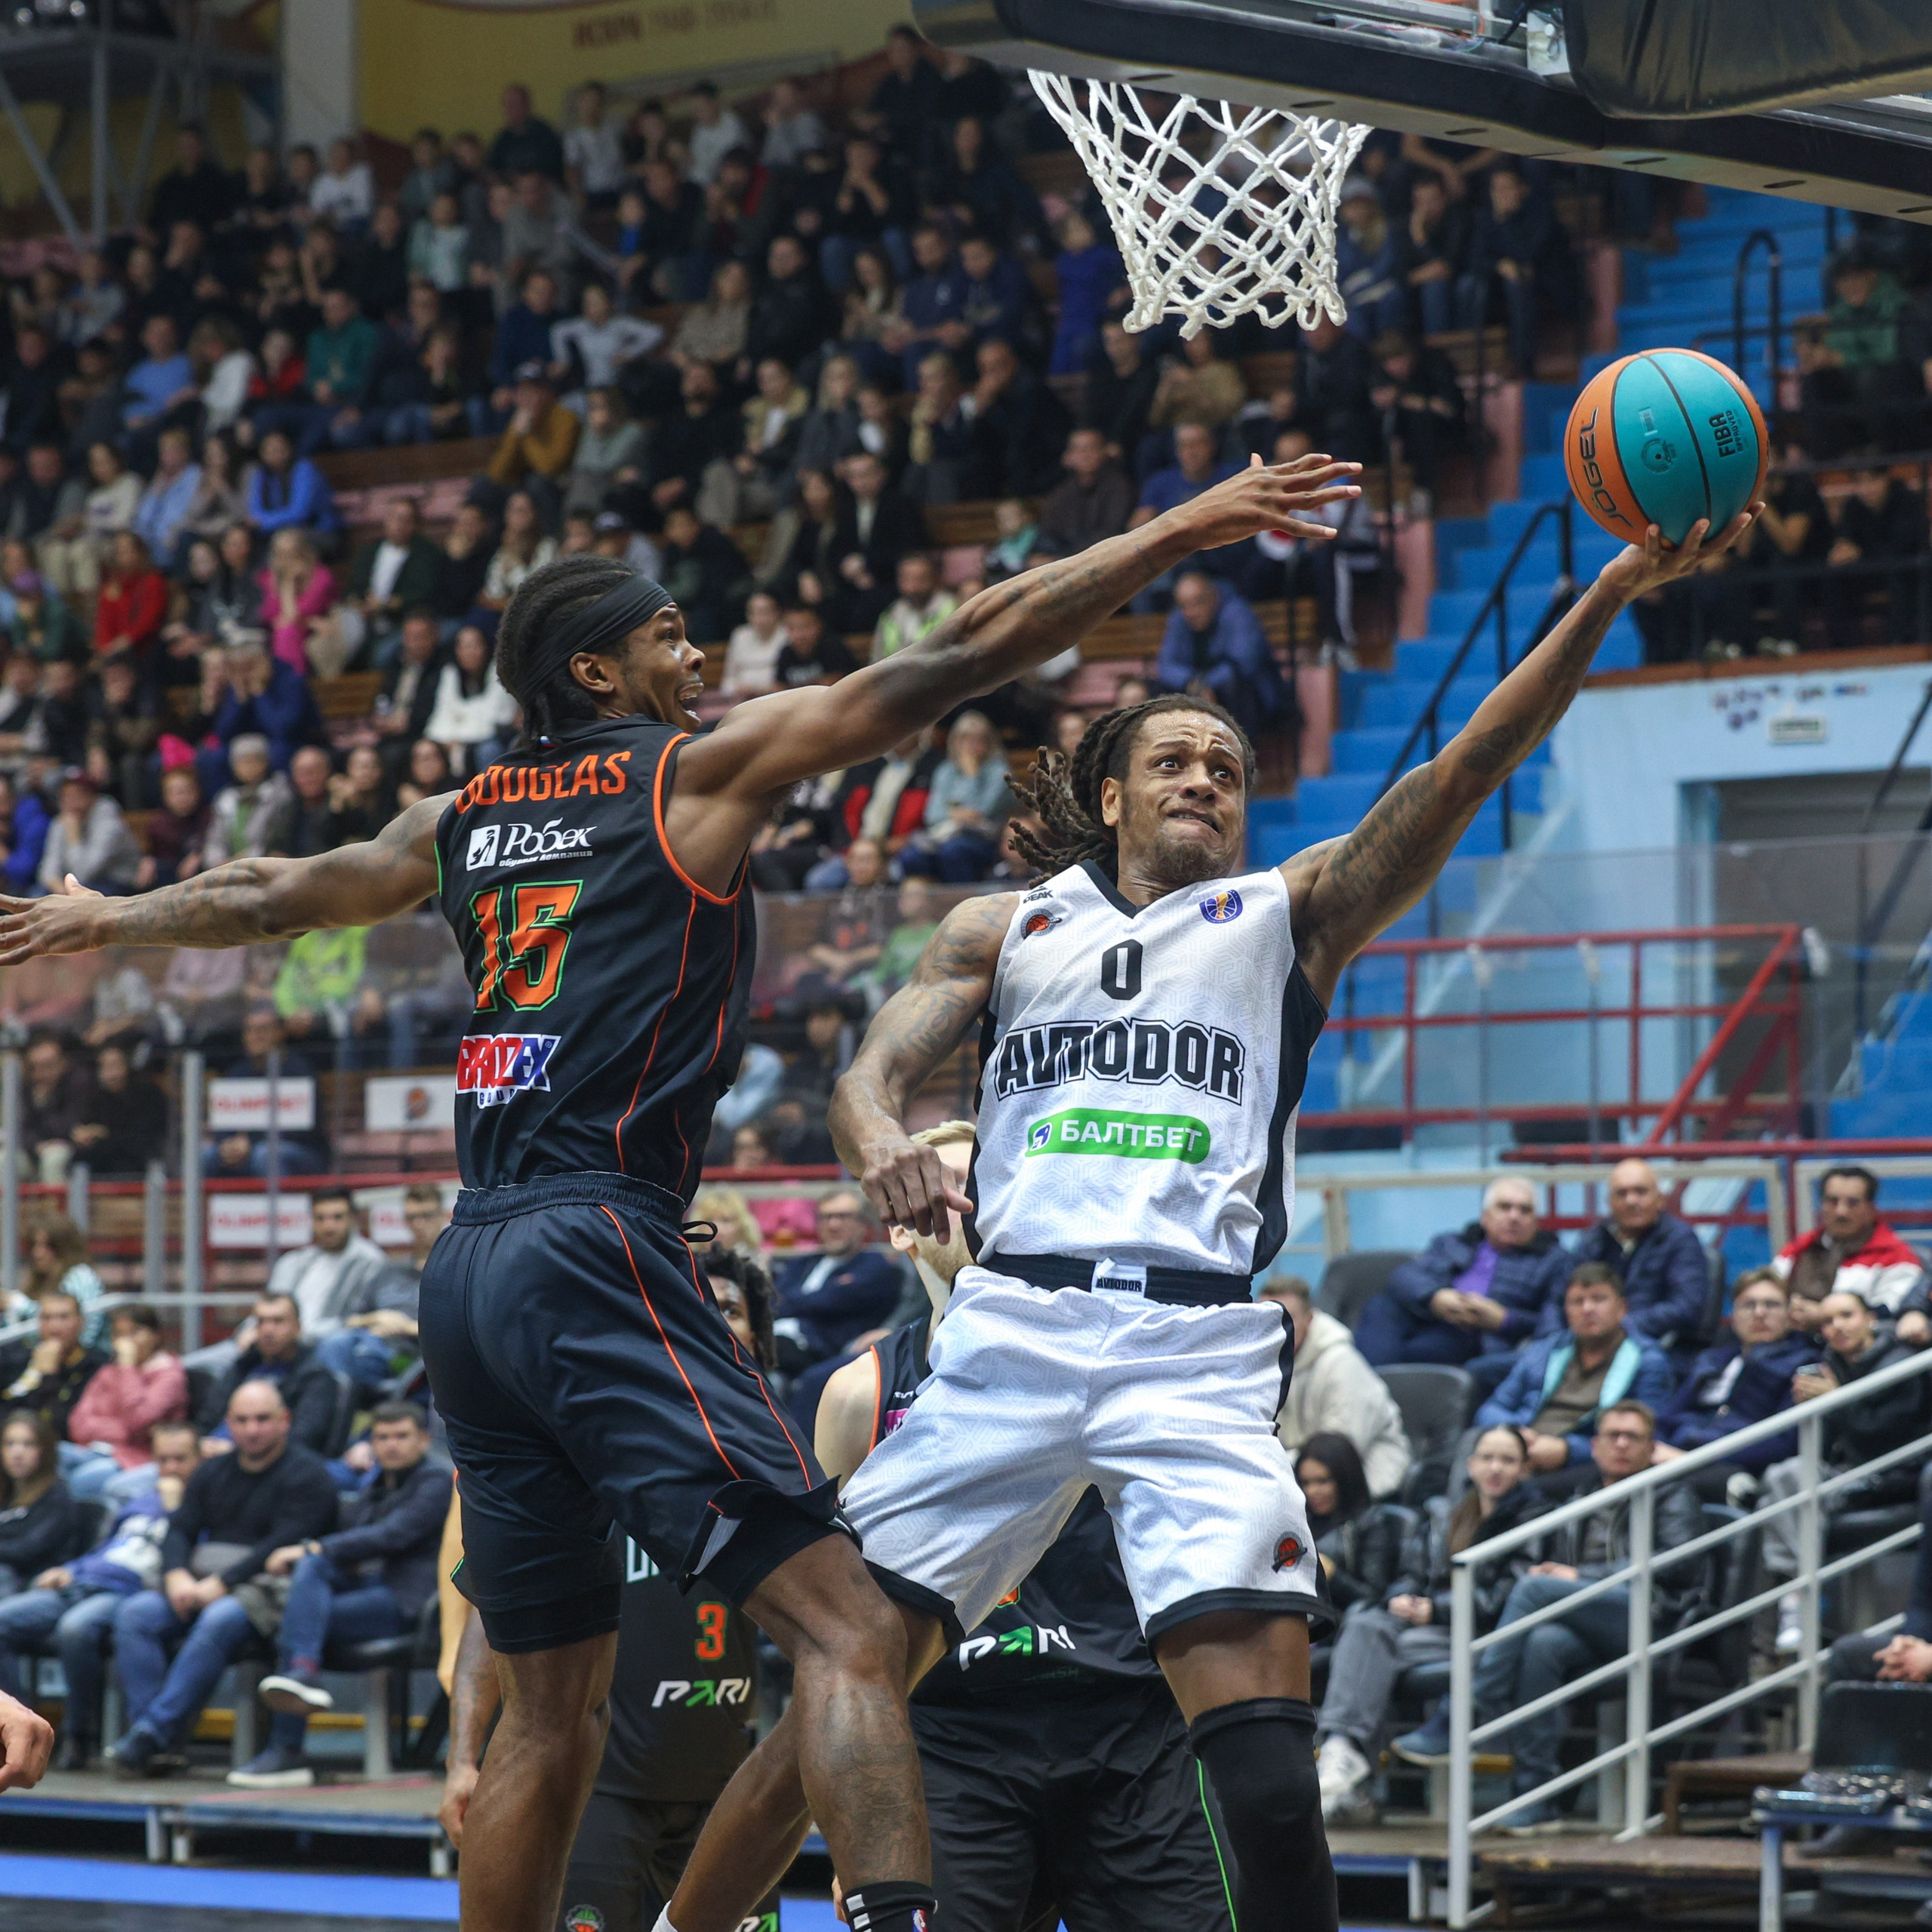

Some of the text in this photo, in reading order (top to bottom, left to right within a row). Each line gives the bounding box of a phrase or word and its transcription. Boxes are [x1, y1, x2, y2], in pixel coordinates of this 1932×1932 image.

[1709, 413, 1736, 457] FIBA
[455, 751, 632, 815] DOUGLAS
[503, 817, 598, 856] Робек
[1023, 891, 1054, 904] PEAK
[469, 880, 583, 1014] 15
[1100, 938, 1142, 1001] 0
[994, 1017, 1246, 1106] AVTODOR
[1060, 1118, 1202, 1152] БАЛТБЕТ
[1095, 1276, 1143, 1293] AVTODOR
[695, 1601, 730, 1663] 3
[958, 1624, 1076, 1672] PARI
[651, 1676, 752, 1709] PARI
